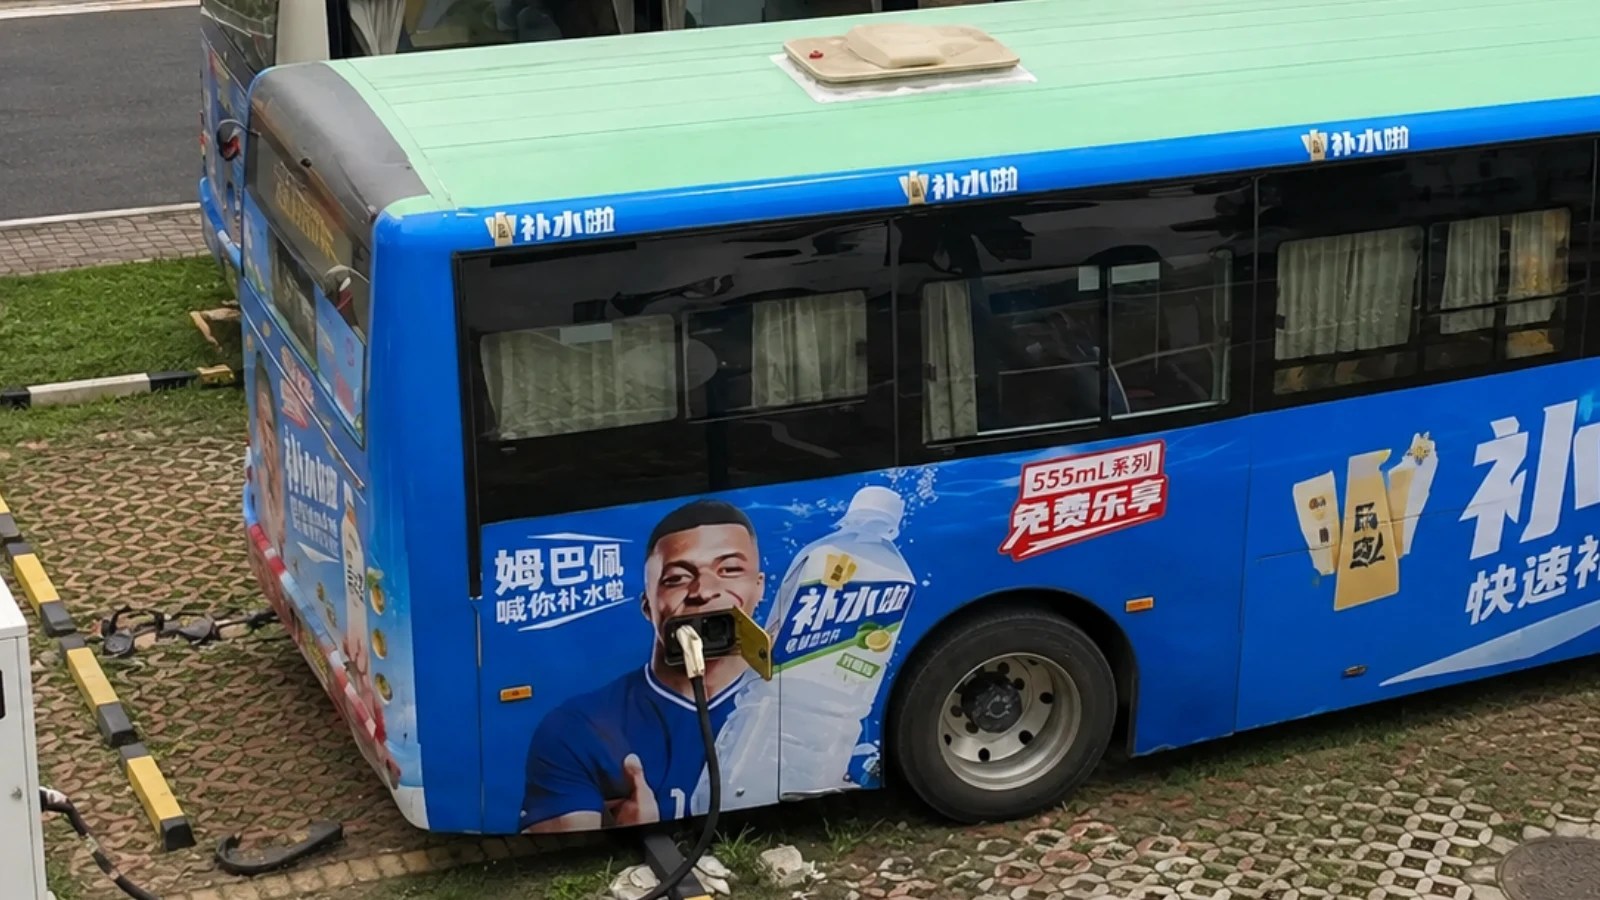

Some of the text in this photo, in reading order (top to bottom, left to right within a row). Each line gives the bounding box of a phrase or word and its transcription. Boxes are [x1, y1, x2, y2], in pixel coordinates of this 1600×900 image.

[1331, 126, 1408, 156] 补水啦
[932, 166, 1018, 199] 补水啦
[521, 206, 615, 241] 补水啦
[1032, 451, 1152, 492] 555mL系列
[1003, 478, 1165, 550] 免费乐享
[495, 544, 624, 595] 姆巴佩
[496, 580, 624, 624] 喊你补水啦
[791, 585, 910, 636] 补水啦
